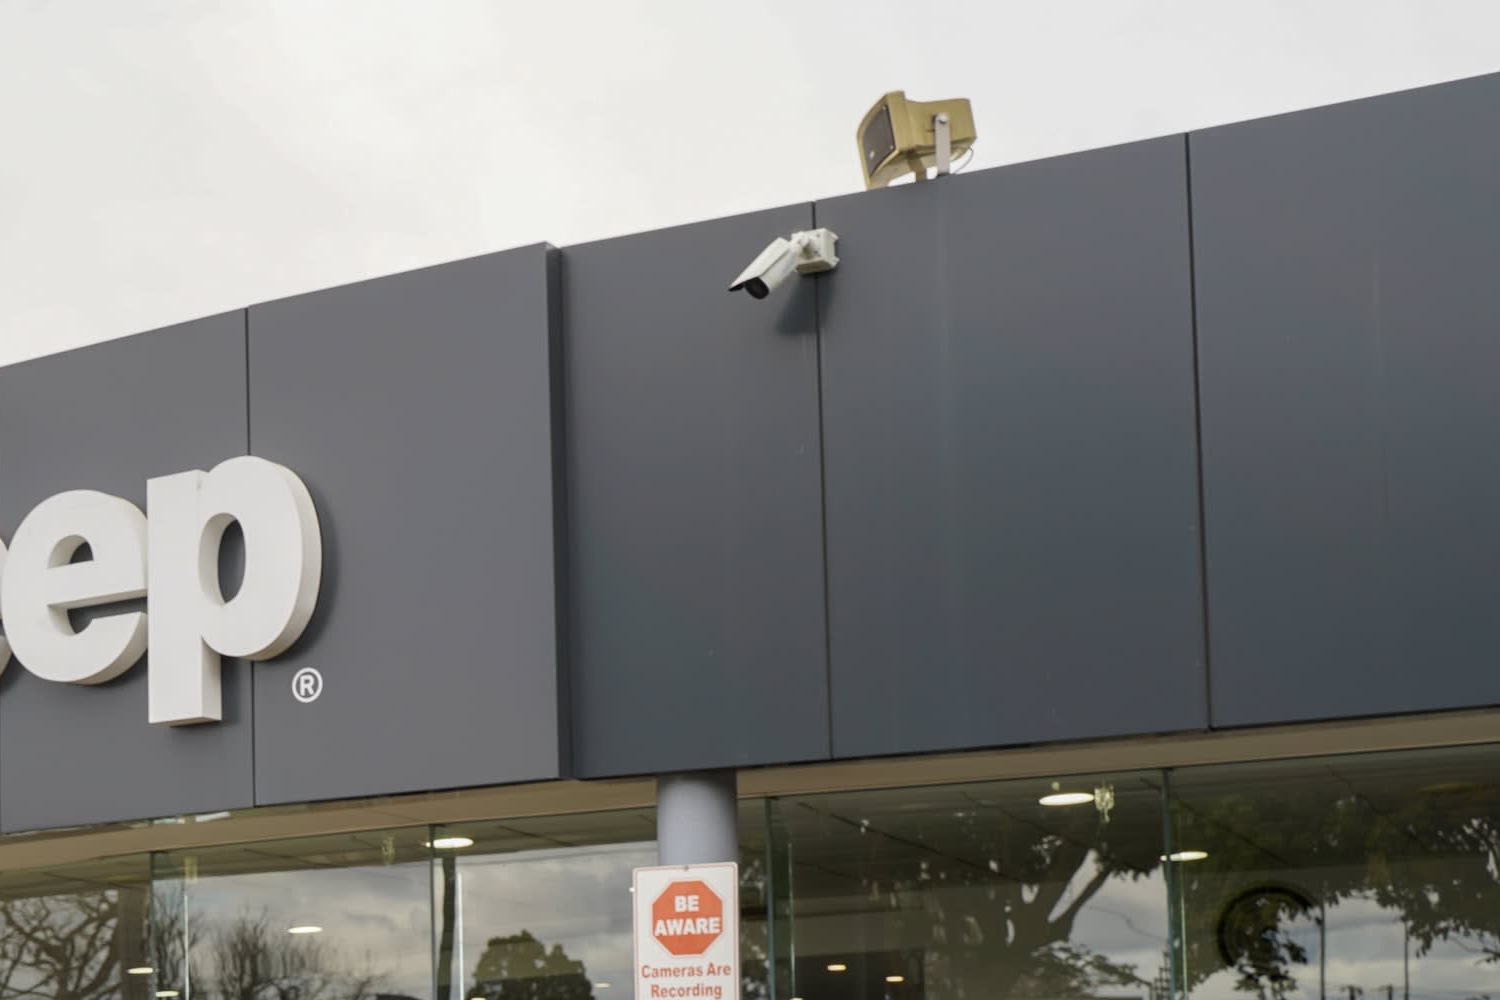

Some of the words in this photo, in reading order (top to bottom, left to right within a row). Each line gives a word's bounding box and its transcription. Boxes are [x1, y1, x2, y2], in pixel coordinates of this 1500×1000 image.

[674, 895, 700, 912] BE
[654, 917, 720, 936] AWARE
[641, 964, 703, 978] Cameras
[706, 962, 731, 976] Are
[651, 983, 722, 999] Recording
